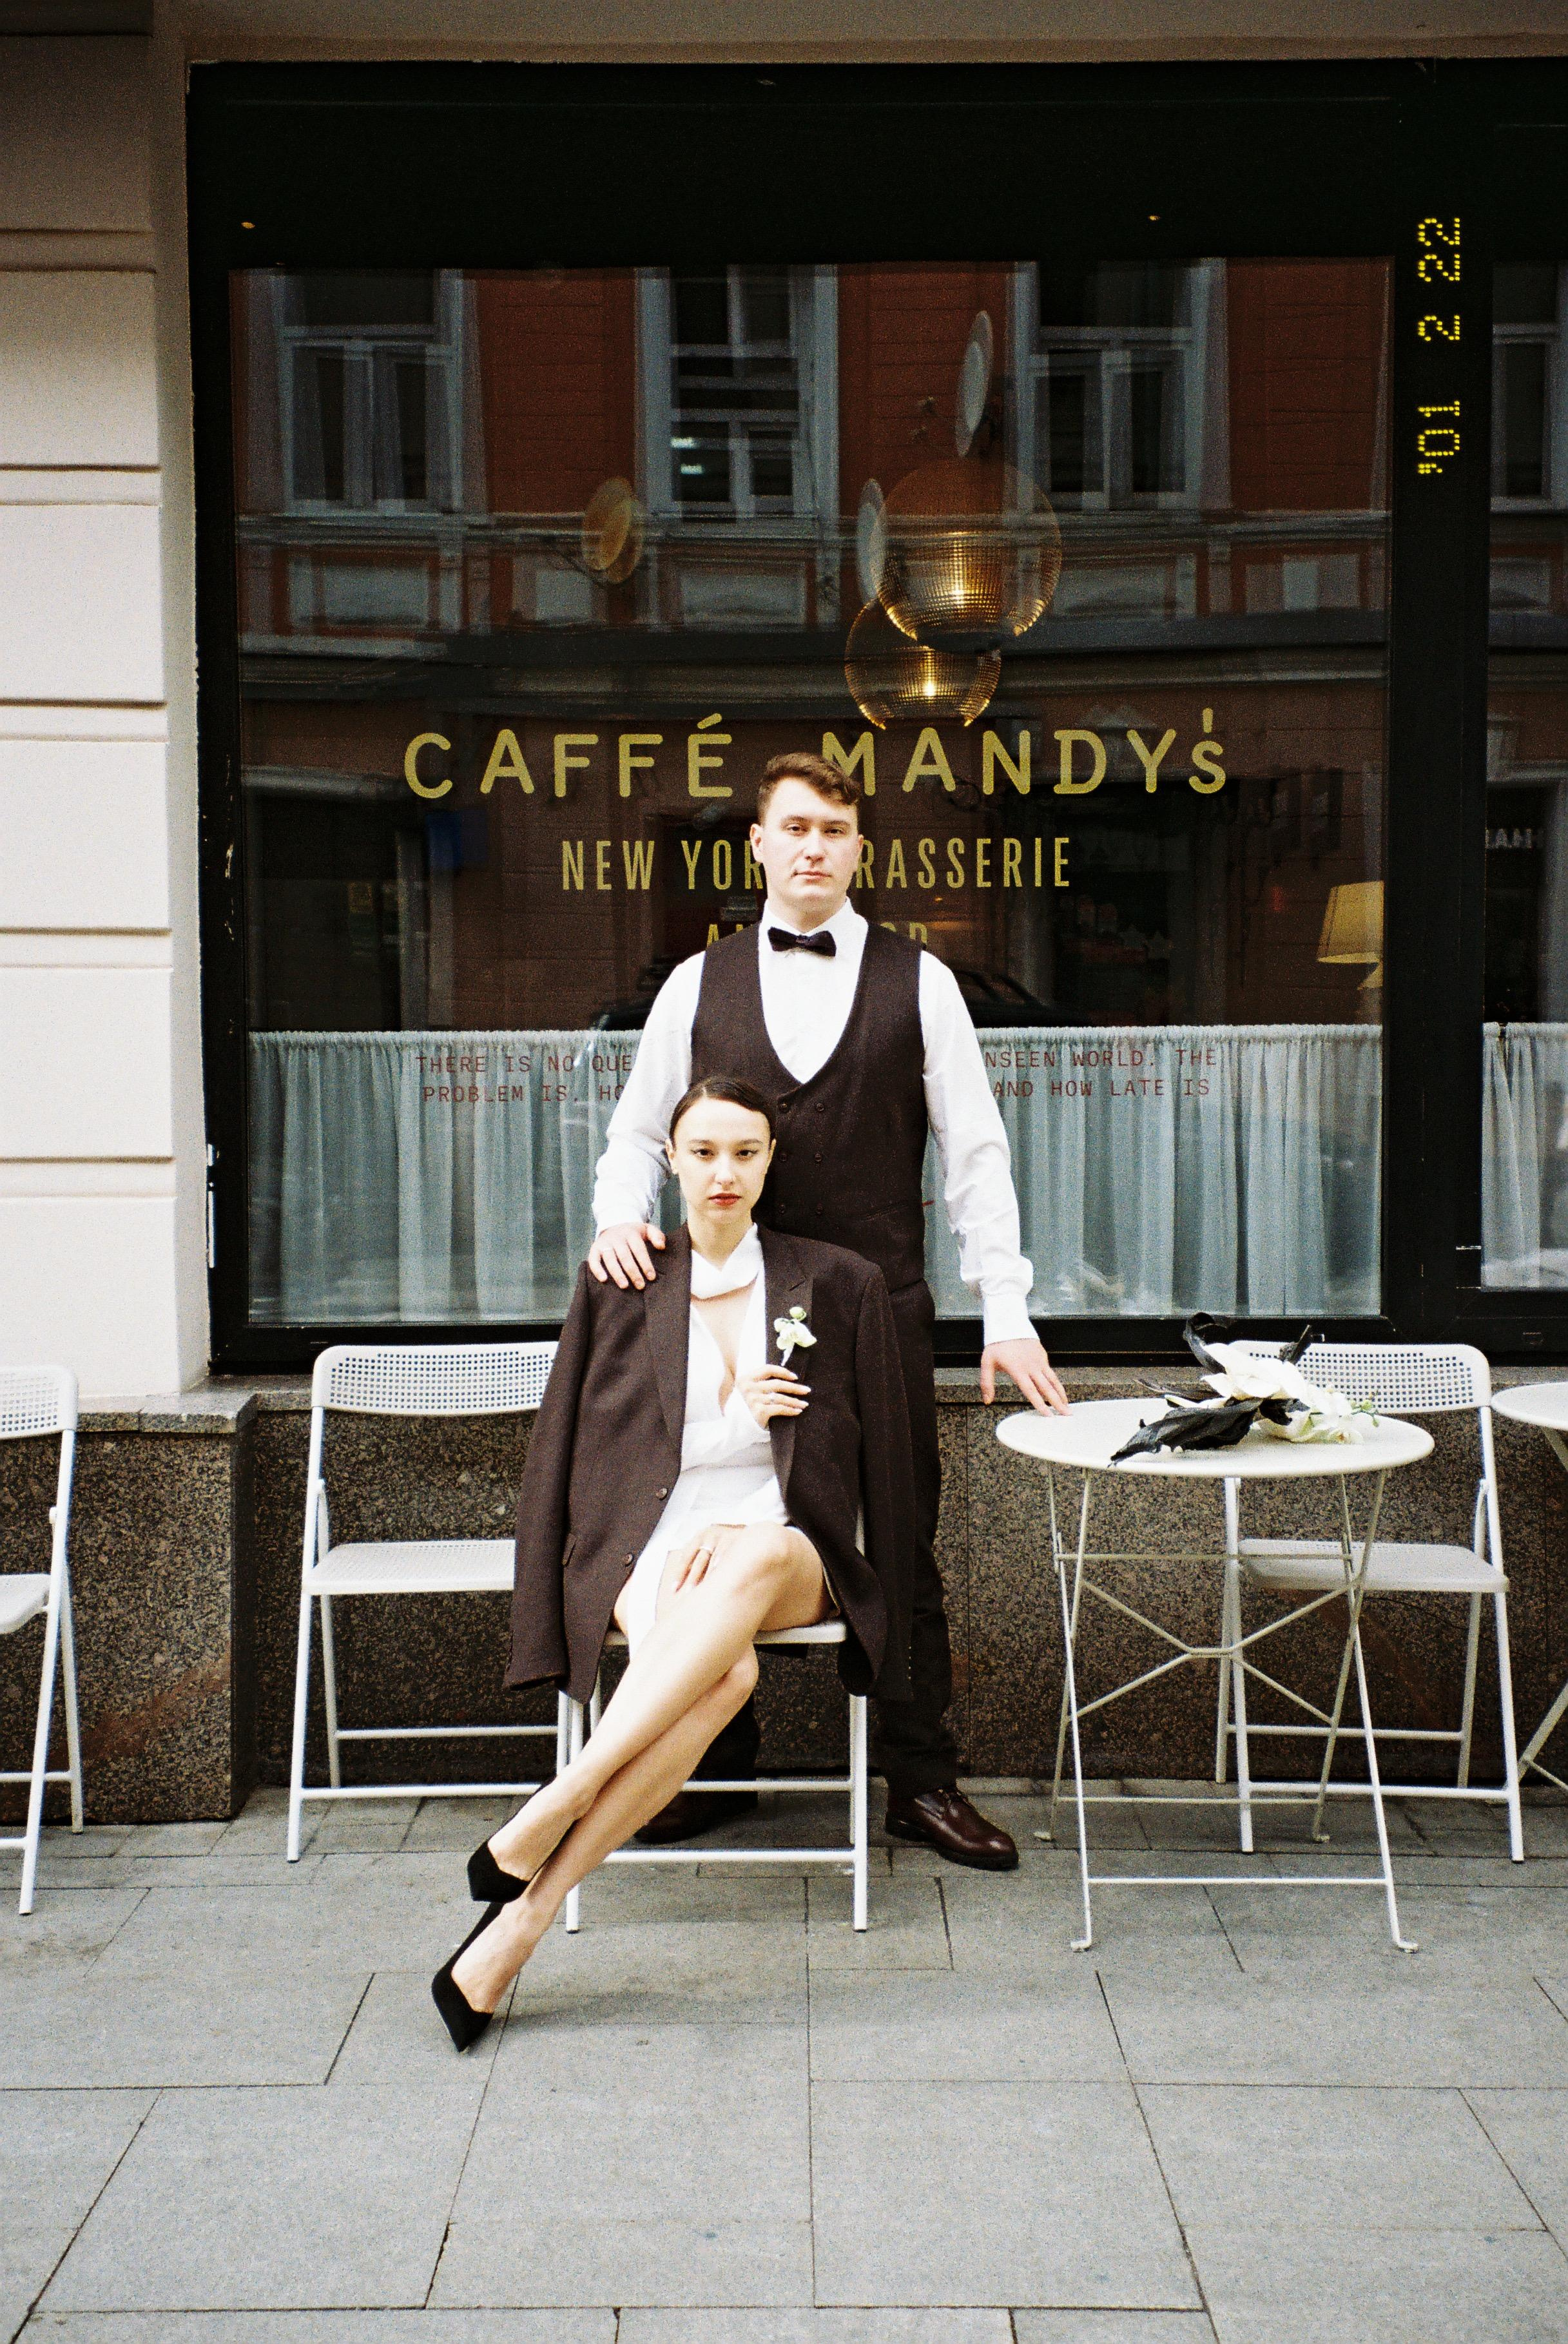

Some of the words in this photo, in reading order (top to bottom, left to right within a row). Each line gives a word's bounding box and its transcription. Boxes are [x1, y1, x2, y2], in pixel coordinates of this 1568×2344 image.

[404, 713, 733, 799] CAFFÉ
[562, 840, 654, 890] NEW
[681, 840, 763, 890] YOR
[854, 837, 1070, 888] RASSERIE
[416, 1056, 486, 1073] THERE
[506, 1056, 530, 1072] IS
[548, 1055, 575, 1072] NO
[592, 1054, 632, 1073] QUE
[985, 1051, 1056, 1068] NSEEN
[1072, 1050, 1154, 1067] WORLD.
[1175, 1049, 1217, 1066] THE
[423, 1085, 523, 1103] PROBLEM
[599, 1084, 624, 1101] HO
[993, 1080, 1034, 1098] AND
[1050, 1080, 1092, 1096] HOW
[1110, 1079, 1165, 1096] LATE
[1184, 1078, 1210, 1095] IS
